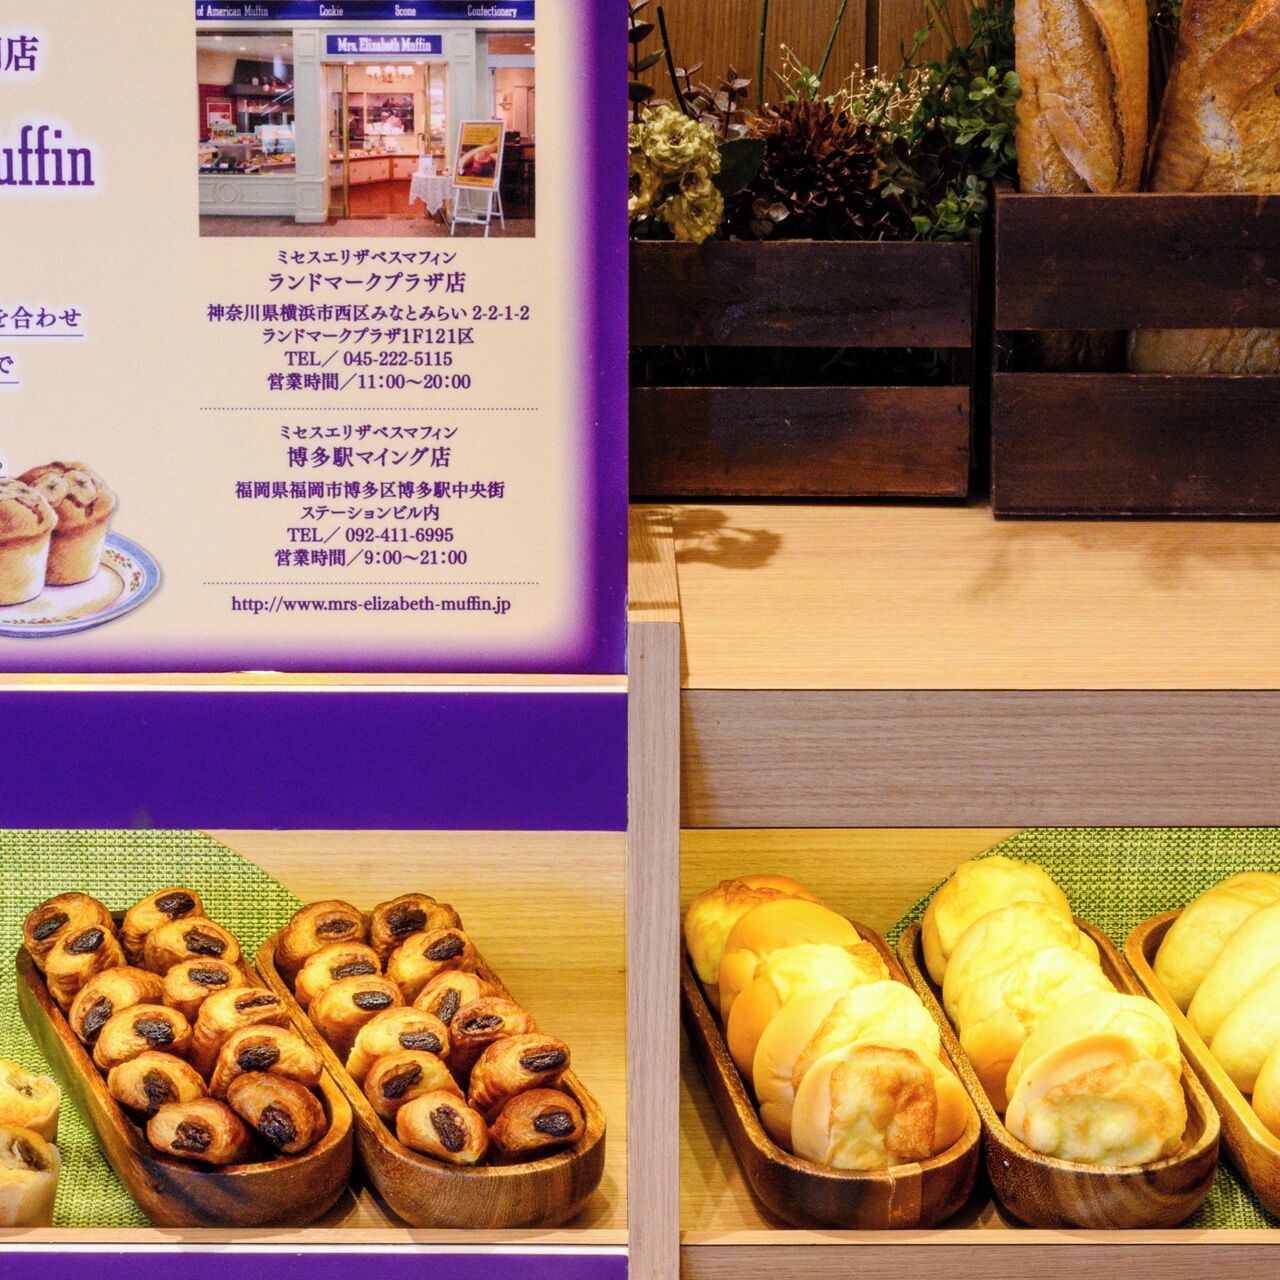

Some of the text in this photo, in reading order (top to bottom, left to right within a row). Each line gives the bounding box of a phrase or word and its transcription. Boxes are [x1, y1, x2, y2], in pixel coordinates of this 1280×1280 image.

[319, 4, 344, 17] Cookie
[394, 4, 417, 17] Scone
[467, 4, 518, 18] Confectionery
[337, 37, 358, 52] Mrs.
[277, 249, 457, 266] ミセスエリザベスマフィン
[268, 271, 467, 294] ランドマークプラザ店
[207, 303, 530, 323] 神奈川県横浜市西区みなとみらい 2-2-1-2
[262, 327, 475, 345] ランドマークプラザ1F121区
[343, 351, 453, 367] 045-222-5115
[279, 424, 458, 441] ミセスエリザベスマフィン
[286, 445, 452, 468] 博多駅マイング店
[235, 480, 506, 500] 福岡県福岡市博多区博多駅中央街
[300, 504, 440, 521] ステーションビル内
[345, 527, 454, 543] 092-411-6995
[231, 595, 512, 615] http://www.mrs-elizabeth-muffin.jp
